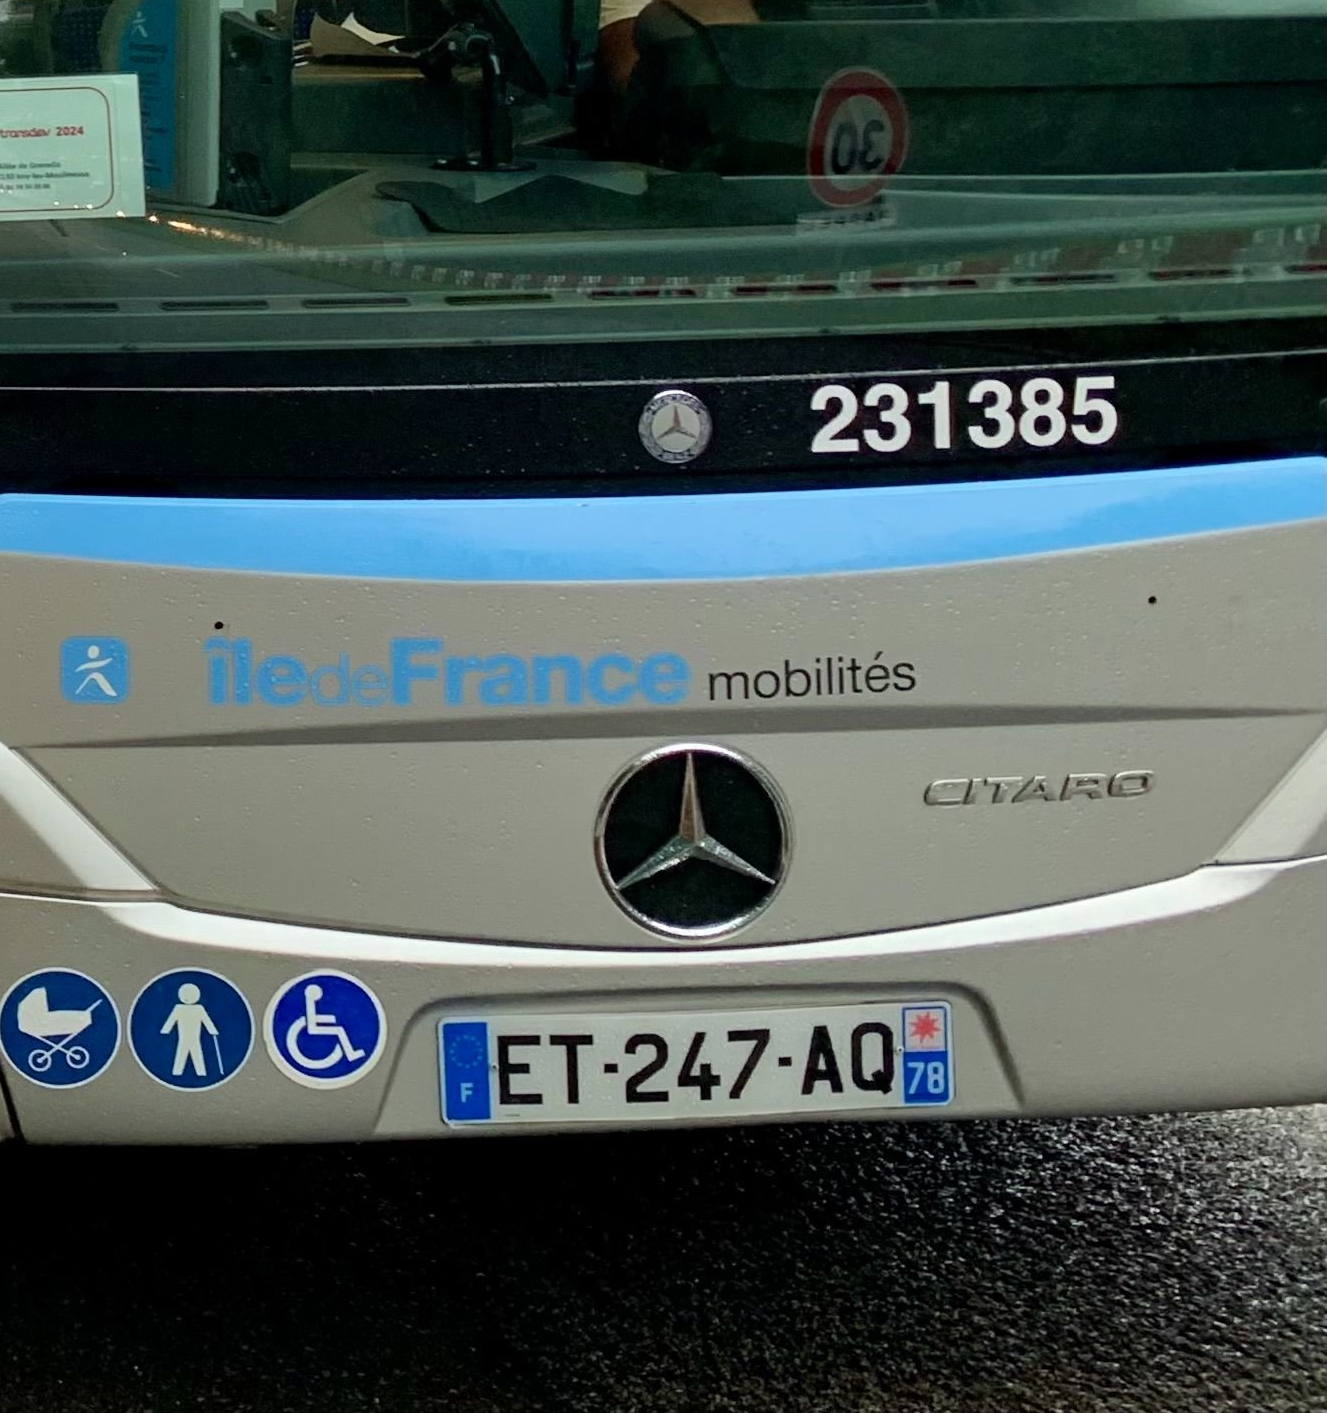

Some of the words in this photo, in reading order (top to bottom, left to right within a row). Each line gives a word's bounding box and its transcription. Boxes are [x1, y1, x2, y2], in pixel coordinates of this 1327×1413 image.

[56, 126, 84, 136] 2024
[810, 376, 1118, 453] 231385
[708, 651, 917, 701] mobilités
[924, 770, 1153, 806] CITARO
[460, 1083, 473, 1102] F
[497, 1022, 896, 1105] ET-247-AQ
[908, 1060, 944, 1095] 78
